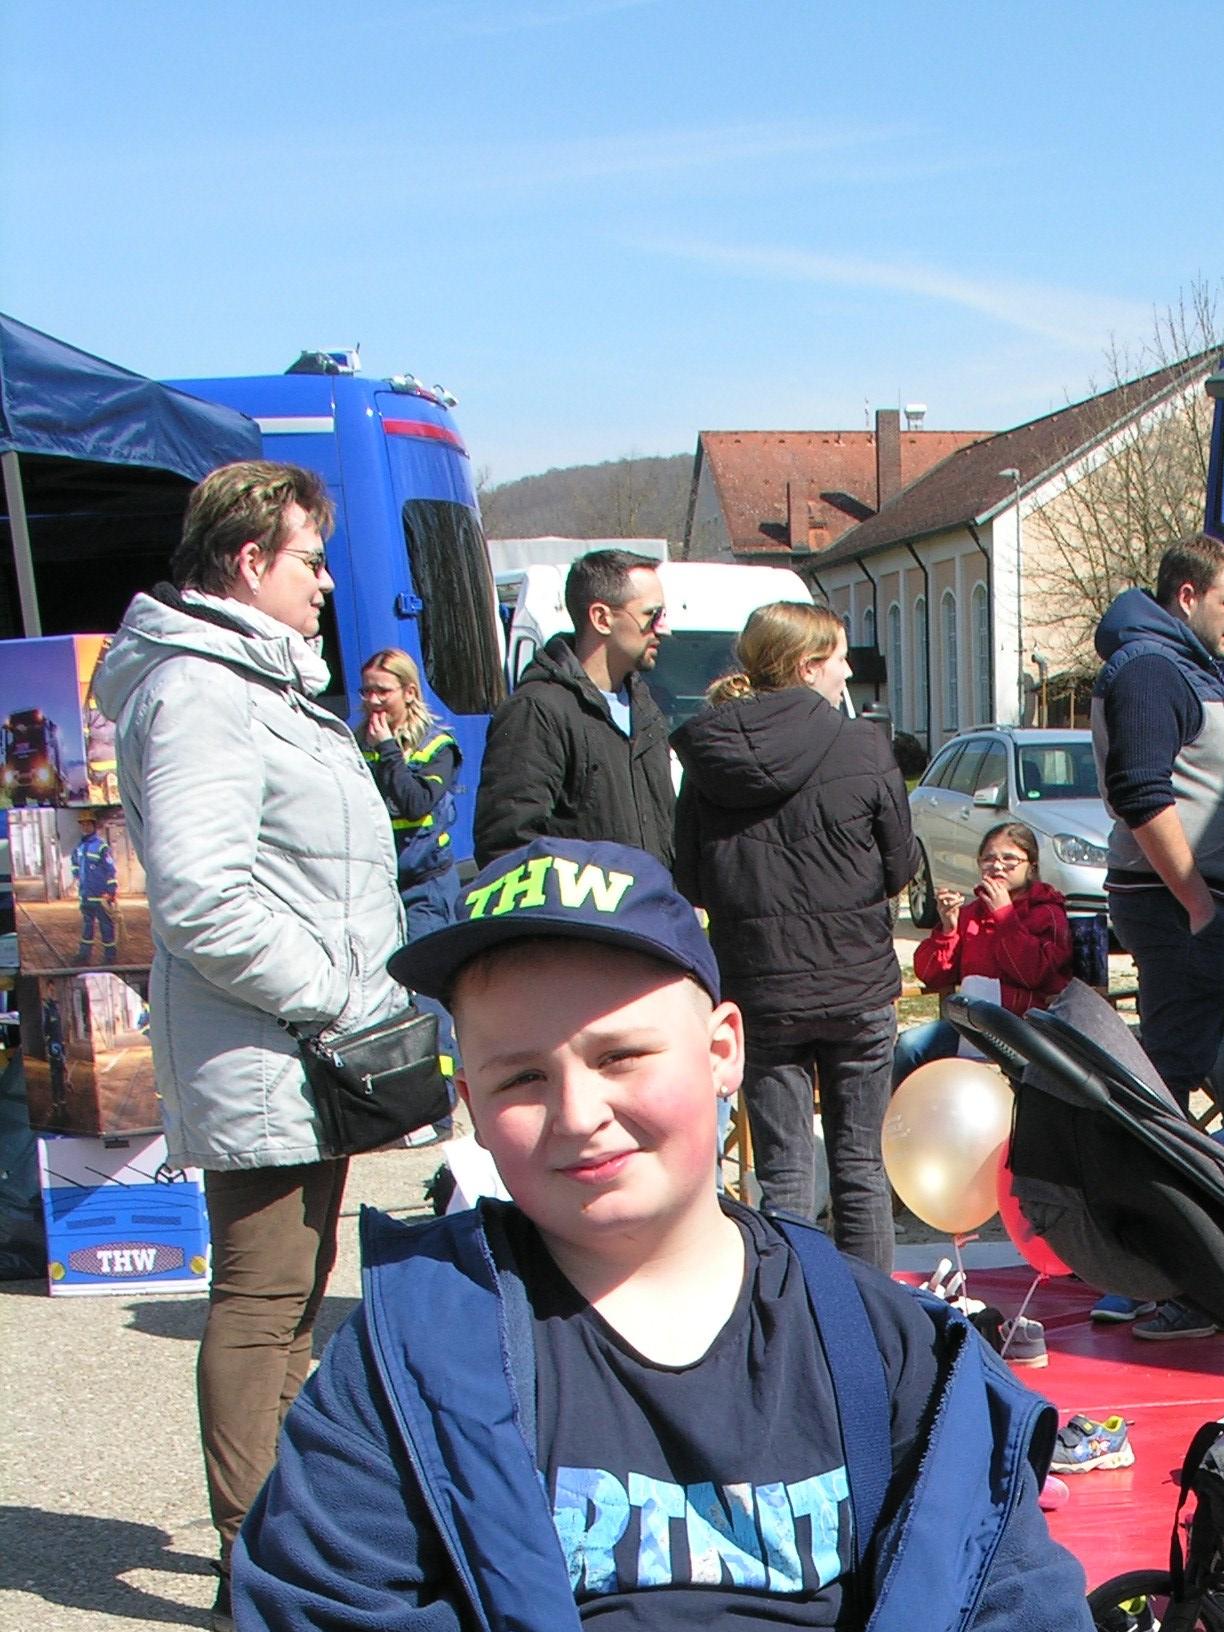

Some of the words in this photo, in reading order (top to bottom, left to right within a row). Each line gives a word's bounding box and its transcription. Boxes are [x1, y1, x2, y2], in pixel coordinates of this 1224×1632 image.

[465, 856, 634, 919] THW
[96, 1248, 157, 1273] THW
[553, 1465, 850, 1594] RTNIT
